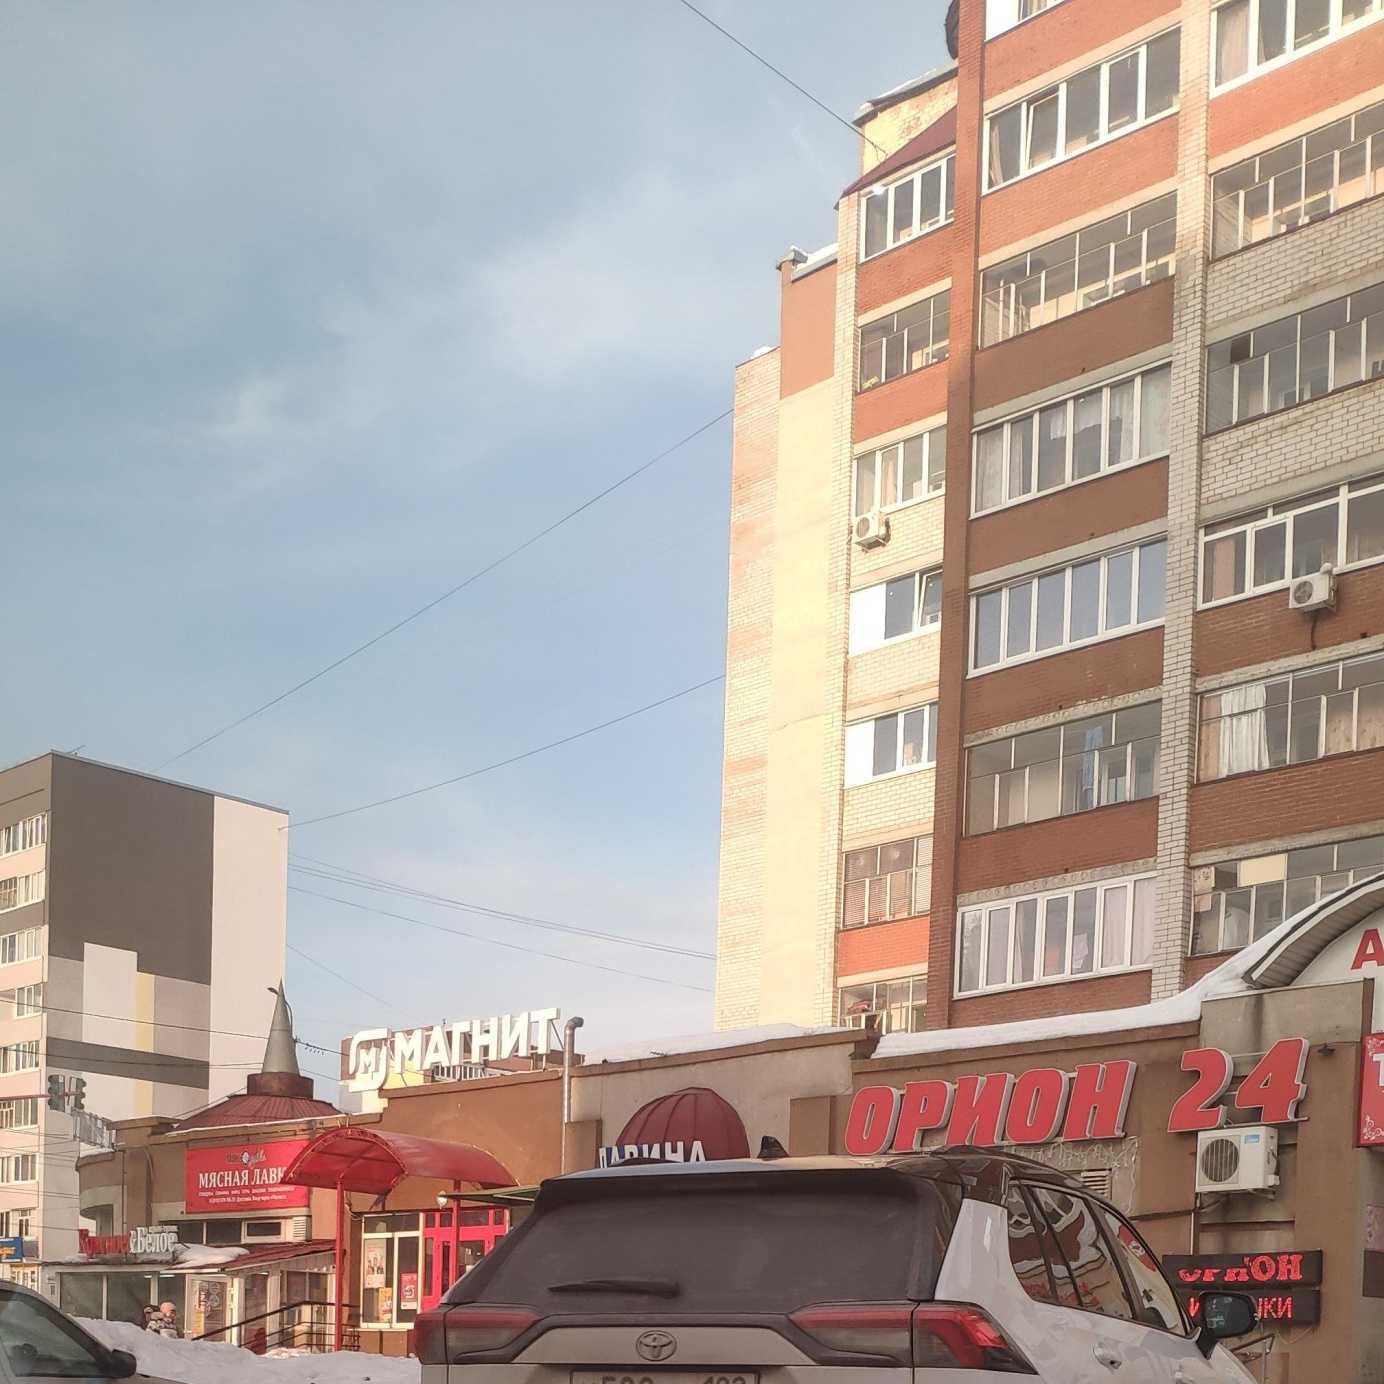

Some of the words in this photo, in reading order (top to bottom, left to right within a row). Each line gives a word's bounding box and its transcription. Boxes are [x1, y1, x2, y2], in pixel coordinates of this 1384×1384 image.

[393, 1008, 559, 1073] МАГНИТ
[845, 1060, 1137, 1155] ОРИОН
[1168, 1037, 1310, 1133] 24
[198, 1169, 250, 1189] МЯСНАЯ
[251, 1166, 287, 1185] ЛАВК
